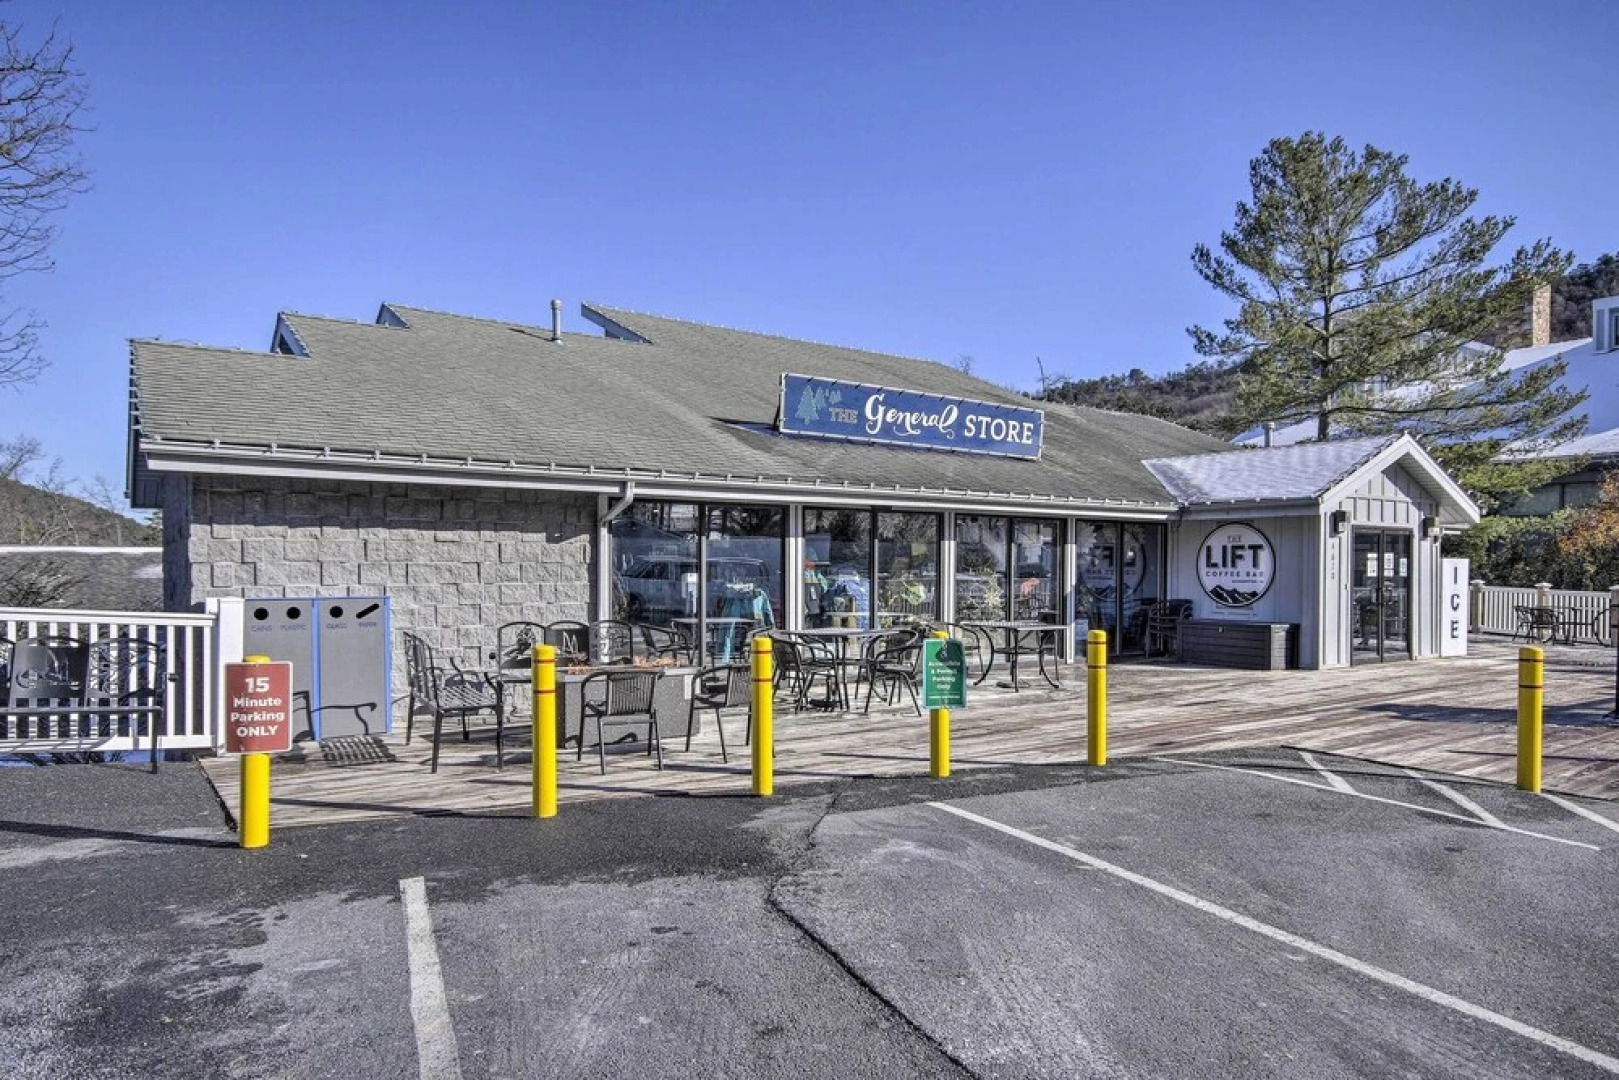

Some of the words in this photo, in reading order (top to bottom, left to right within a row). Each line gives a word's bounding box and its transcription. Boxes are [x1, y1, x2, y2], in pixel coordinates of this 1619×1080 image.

[829, 407, 859, 424] THE
[864, 393, 959, 439] General
[964, 414, 1034, 445] STORE
[1205, 543, 1264, 569] LIFT
[1205, 570, 1241, 578] COFFEE
[1450, 566, 1460, 639] ICE
[244, 676, 270, 694] 15
[233, 697, 282, 708] Minute
[230, 711, 285, 722] Parking
[236, 725, 279, 738] ONLY
